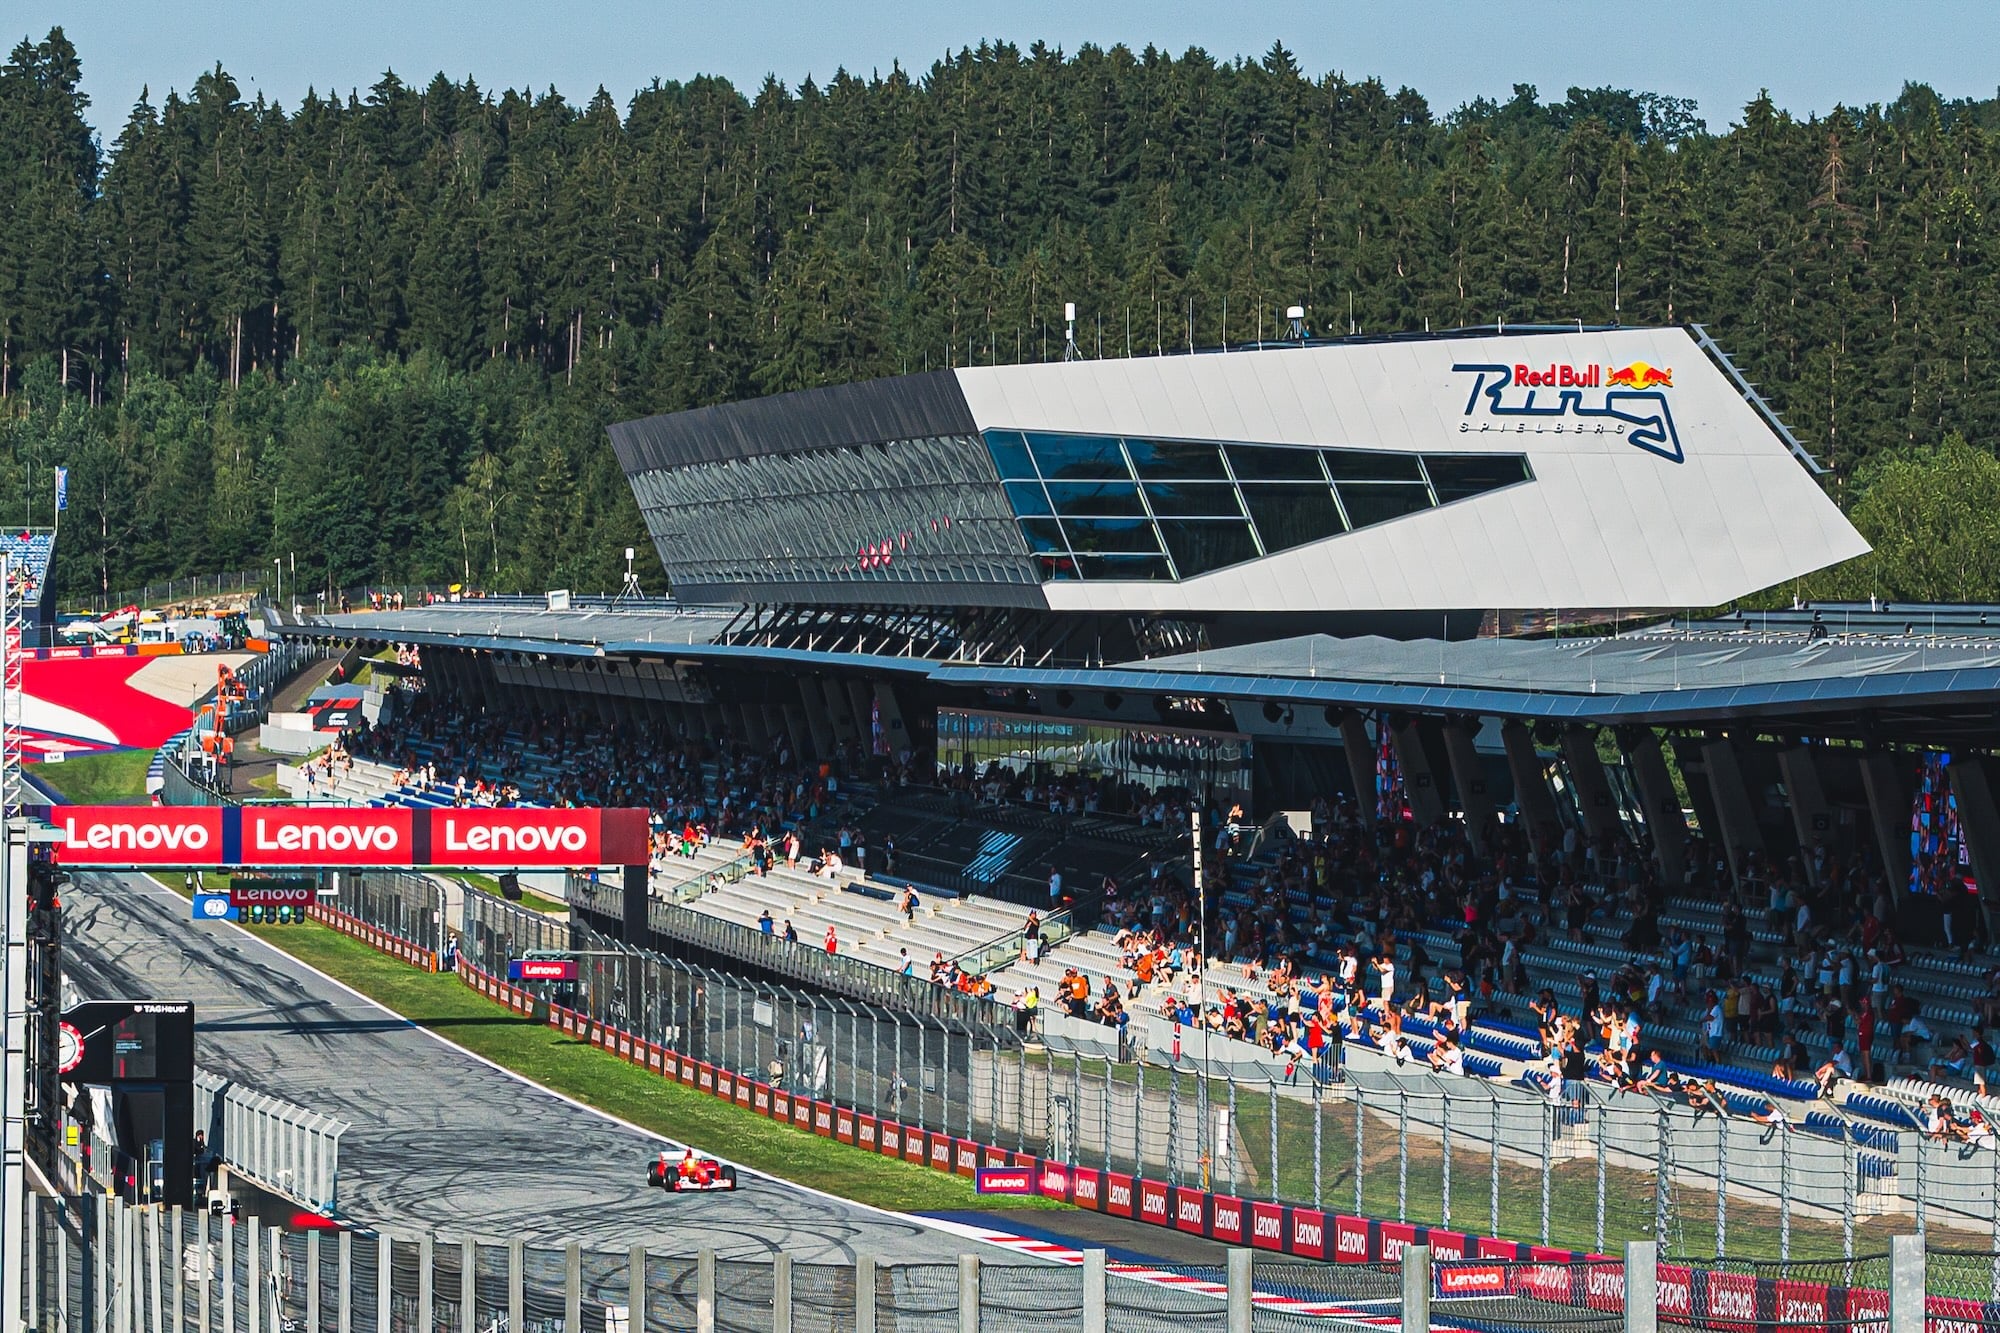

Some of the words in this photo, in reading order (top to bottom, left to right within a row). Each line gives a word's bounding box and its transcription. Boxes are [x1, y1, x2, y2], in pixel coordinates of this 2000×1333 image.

[1514, 364, 1556, 387] Red
[1559, 364, 1600, 388] Bull
[1459, 421, 1625, 435] SPIELBERG
[67, 817, 208, 850] Lenovo
[256, 818, 399, 851] Lenovo
[446, 819, 587, 851] Lenovo
[237, 889, 308, 901] Lenovo
[525, 965, 562, 975] Lenovo
[931, 1138, 949, 1163] Lenovo
[957, 1145, 976, 1170] Lenovo
[985, 1176, 1026, 1188] Lenovo
[1044, 1165, 1065, 1193] Lenovo
[1075, 1172, 1097, 1200] Lenovo
[1108, 1179, 1131, 1207] Lenovo
[1142, 1187, 1166, 1216] Lenovo
[1178, 1194, 1202, 1224] Lenovo
[1214, 1202, 1240, 1232] Lenovo
[1254, 1210, 1281, 1239] Lenovo
[1294, 1216, 1322, 1248] Lenovo
[1337, 1224, 1366, 1256] Lenovo
[1447, 1272, 1499, 1287] Lenovo
[1656, 1280, 1688, 1310] enovo
